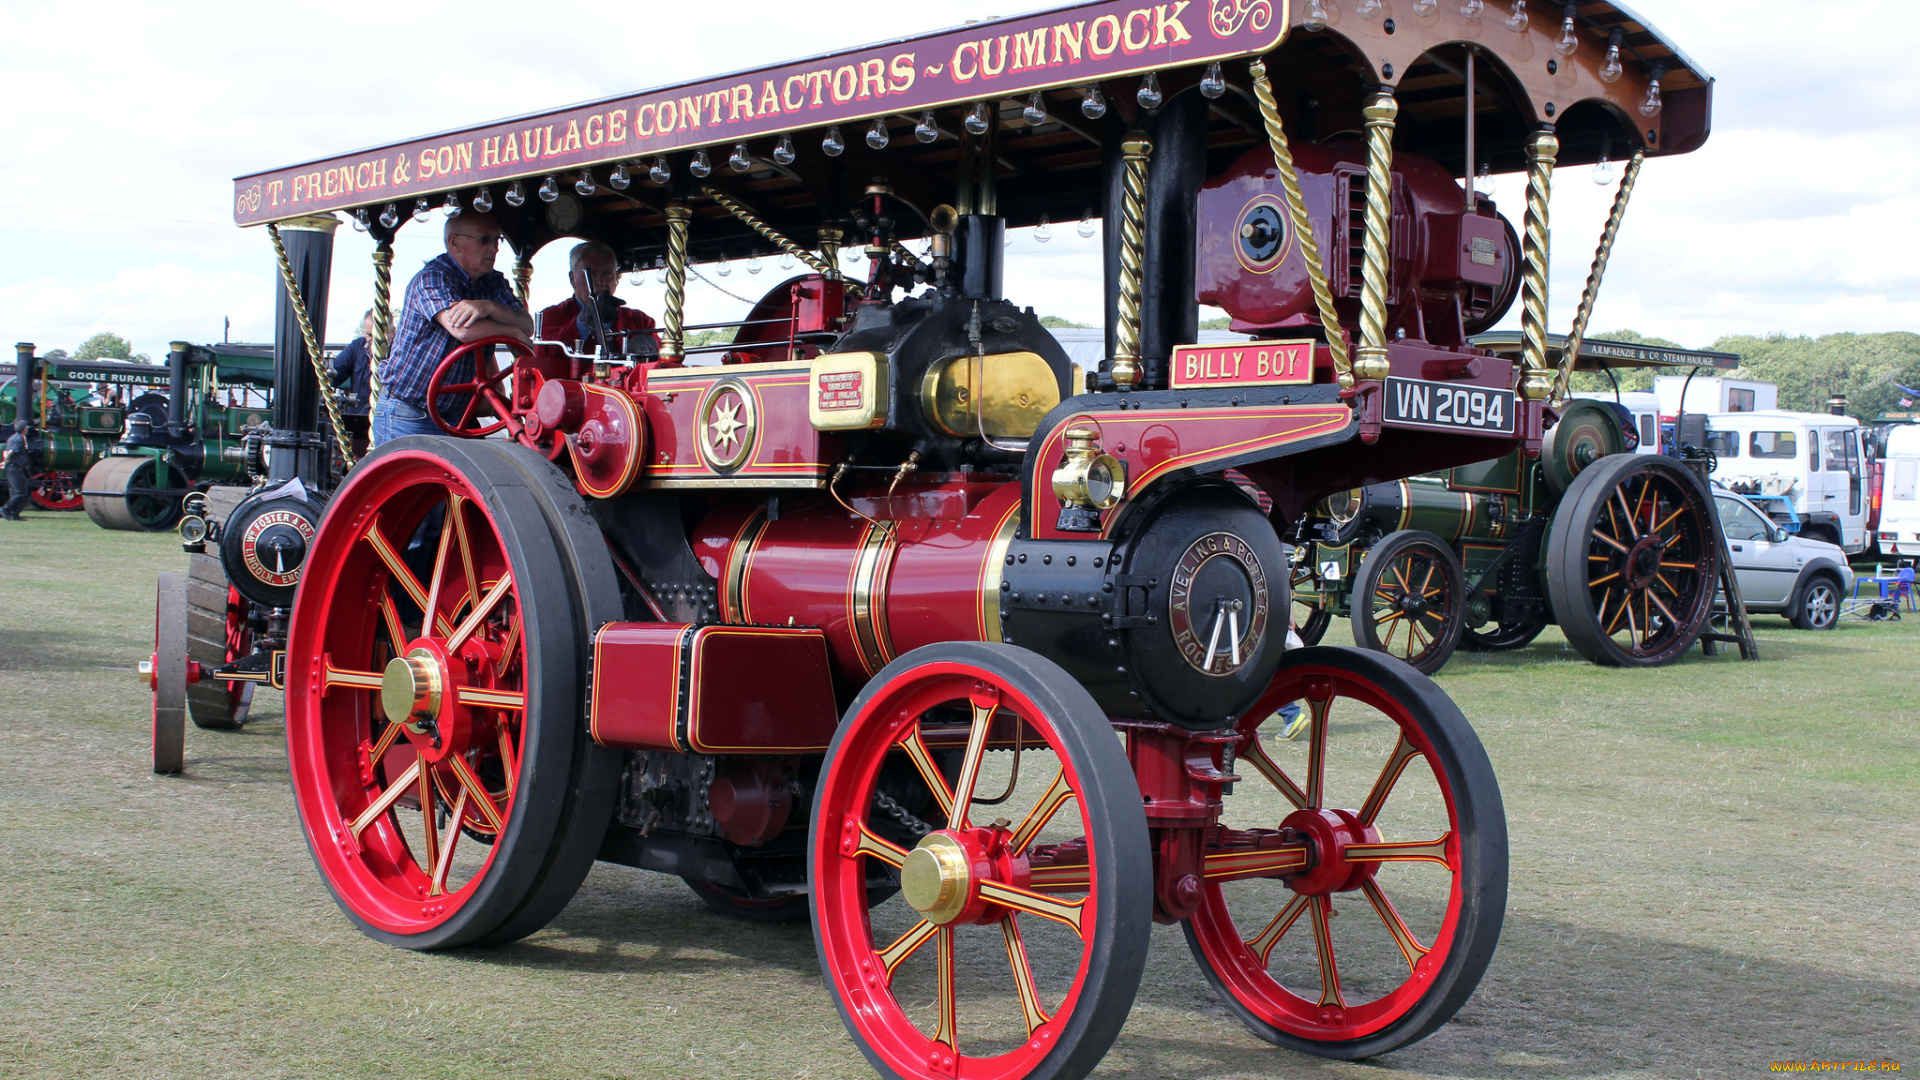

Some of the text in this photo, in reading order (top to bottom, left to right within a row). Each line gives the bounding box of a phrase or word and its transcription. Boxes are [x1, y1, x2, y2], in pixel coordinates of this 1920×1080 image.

[266, 179, 288, 207] T.
[292, 158, 388, 201] FRENCH
[393, 152, 412, 186] &
[418, 142, 474, 180] SON
[481, 109, 628, 169] HAULAGE
[635, 52, 917, 138] CONTRACTORS
[949, 0, 1193, 85] CUMNOCK
[1185, 348, 1299, 380] BILLY BOY
[1639, 350, 1646, 359] &
[1663, 352, 1686, 363] STEAM
[1686, 355, 1714, 366] HAULAGE
[68, 371, 107, 381] GOOLE
[111, 373, 149, 384] RURAL
[1396, 381, 1504, 429] VN 2094
[253, 513, 290, 531] FOSTER
[292, 516, 299, 525] &
[1172, 536, 1266, 616] AVELING & PORTER
[1176, 629, 1260, 674] ROCESER
